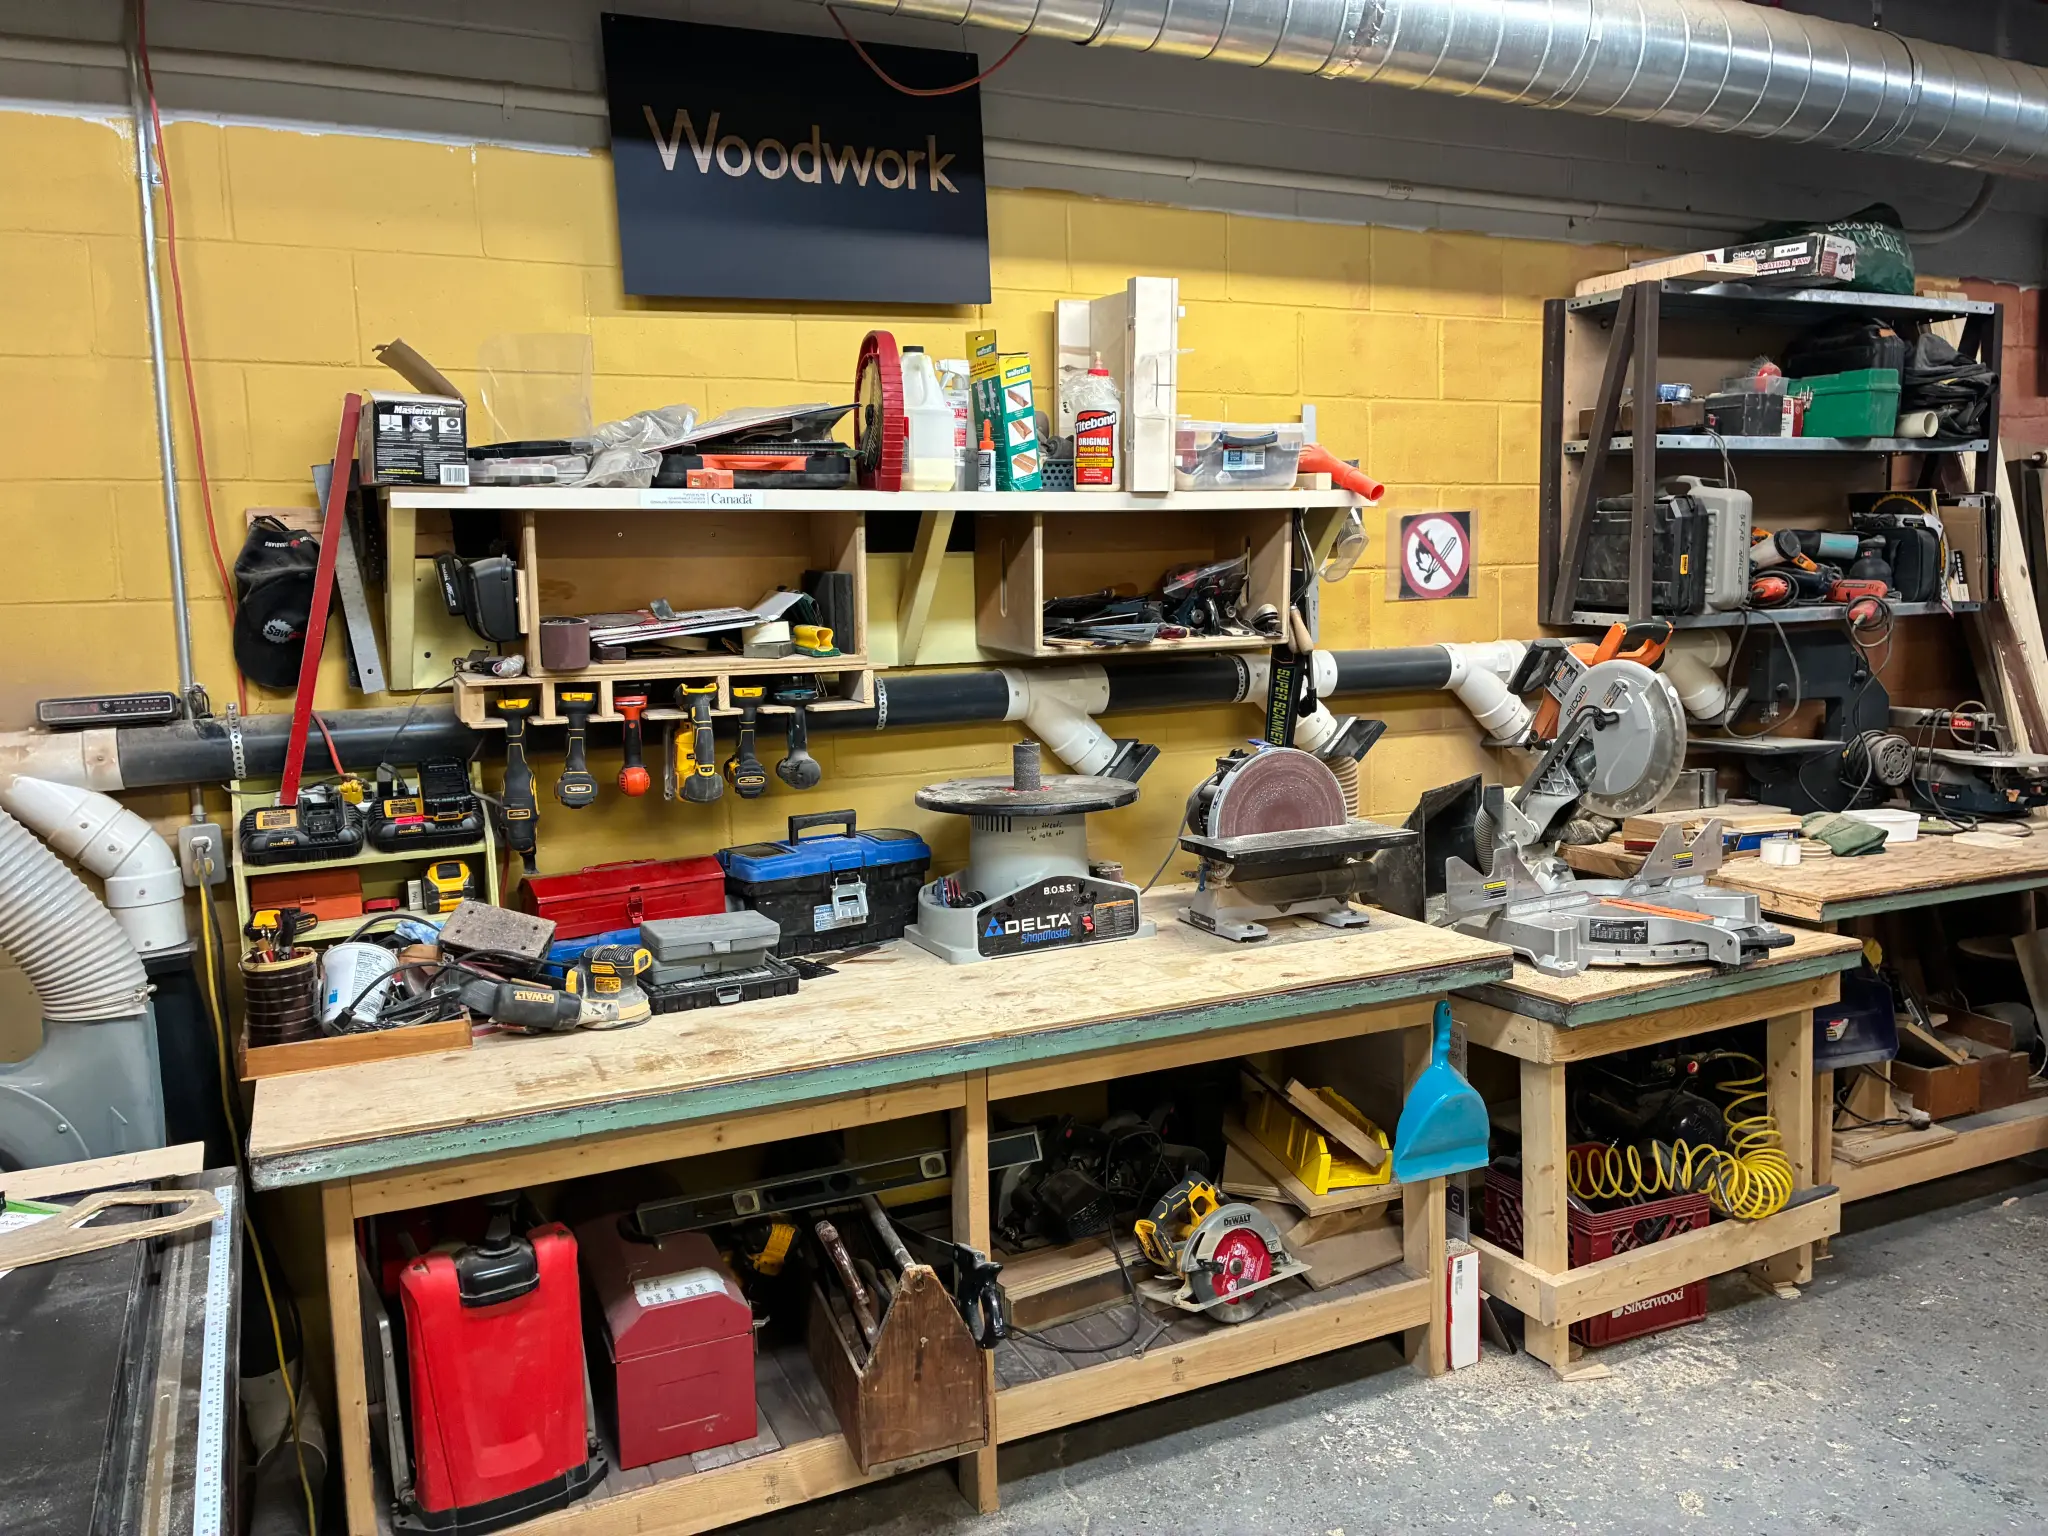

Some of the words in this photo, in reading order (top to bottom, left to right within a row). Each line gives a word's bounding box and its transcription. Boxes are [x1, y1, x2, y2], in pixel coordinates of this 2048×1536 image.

[642, 105, 960, 193] Woodwork
[1733, 248, 1766, 259] CHICAGO
[1757, 260, 1791, 270] OCATING
[1792, 256, 1811, 266] SAW
[394, 405, 446, 416] Mastercraft
[1076, 413, 1116, 433] Titebond
[1079, 438, 1110, 446] ORIGINAL
[711, 493, 752, 504] Canada
[267, 624, 291, 639] Saw
[1274, 668, 1291, 701] SUPER
[1566, 685, 1588, 718] RIDGID
[1270, 700, 1287, 745] SCANNER
[1004, 913, 1071, 935] DELTA
[1021, 928, 1071, 944] ShopMaster
[1624, 1287, 1684, 1315] Silverwood
